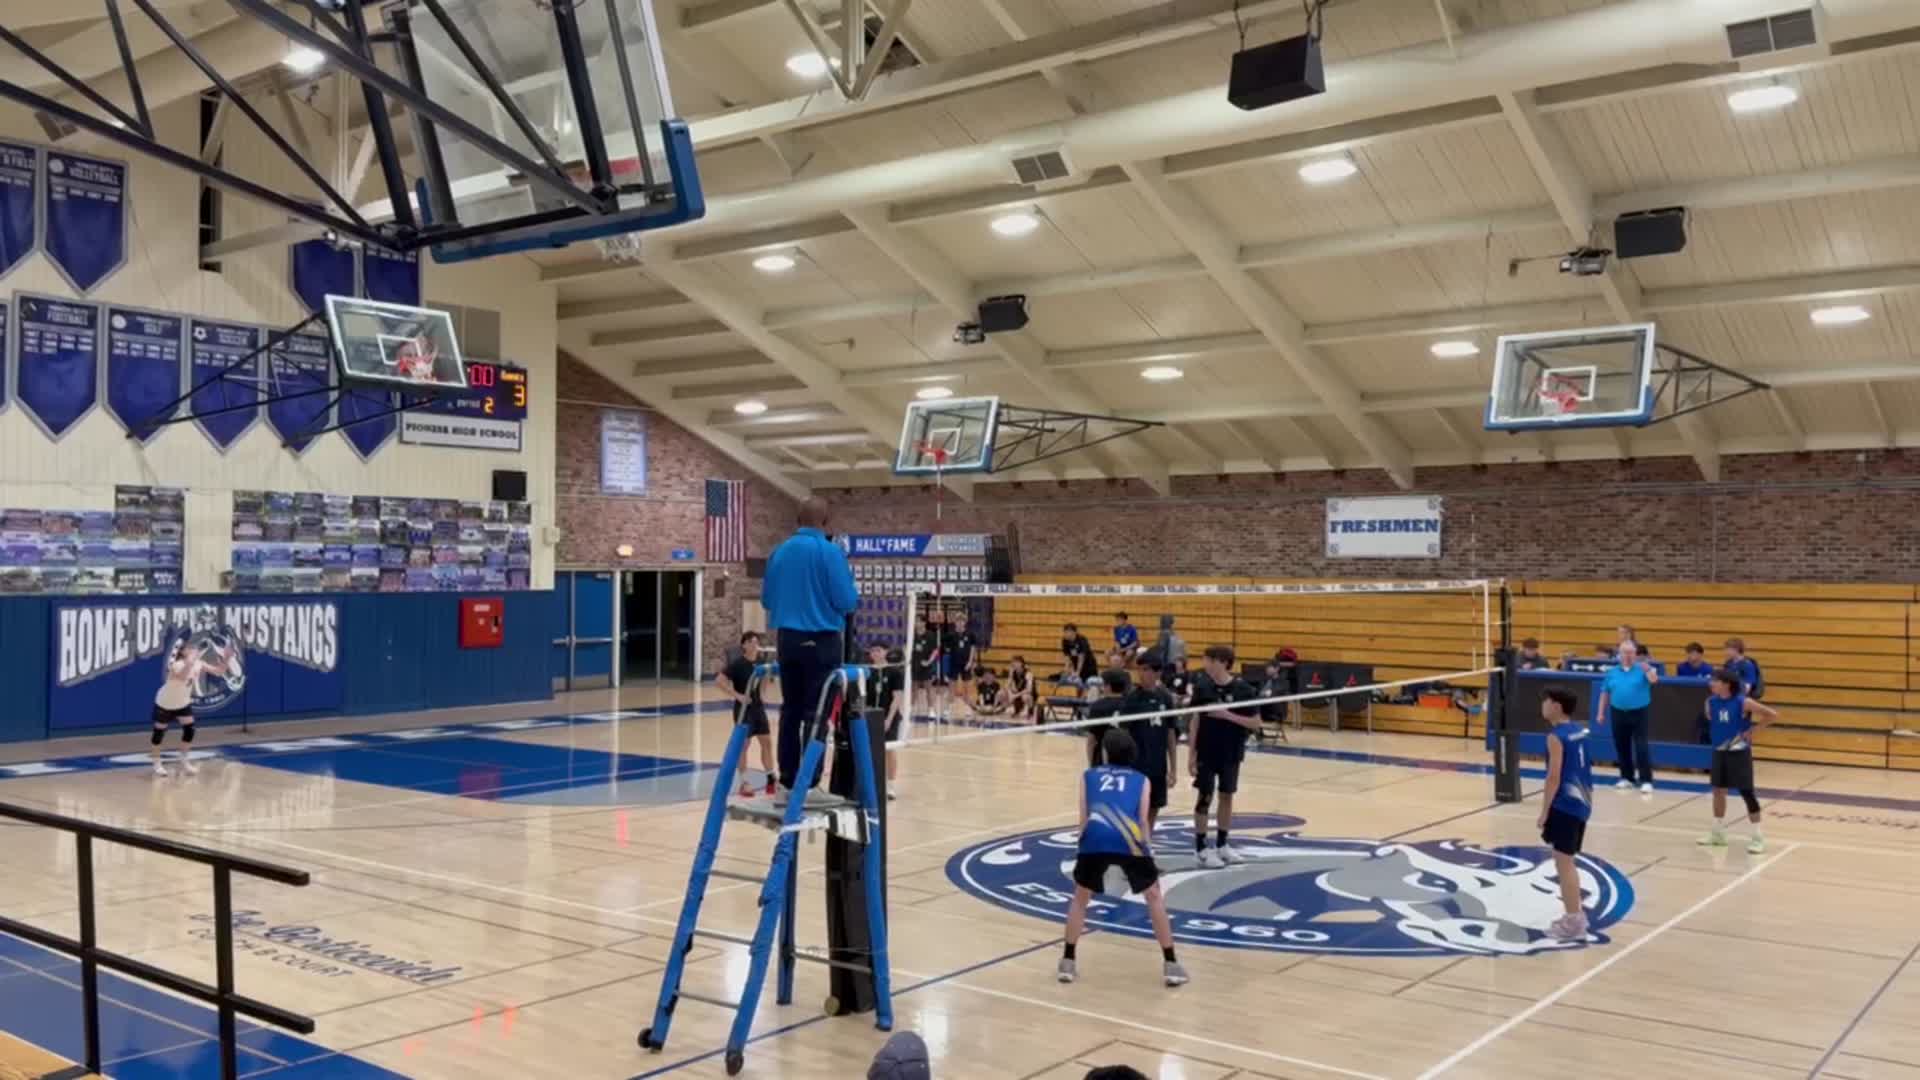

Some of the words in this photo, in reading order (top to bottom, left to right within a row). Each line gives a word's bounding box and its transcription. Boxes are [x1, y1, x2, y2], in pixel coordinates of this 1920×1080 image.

[405, 422, 449, 434] PIONEER
[451, 426, 476, 436] HIGH
[480, 429, 519, 440] SCHOOL
[1330, 518, 1439, 534] FRESHMEN
[855, 538, 881, 552] HALL
[887, 538, 916, 552] FAME
[58, 606, 131, 685] HOME
[136, 606, 167, 655] OF
[225, 604, 337, 672] MUSTANGS
[1099, 774, 1126, 792] 21
[1148, 914, 1331, 943] 960
